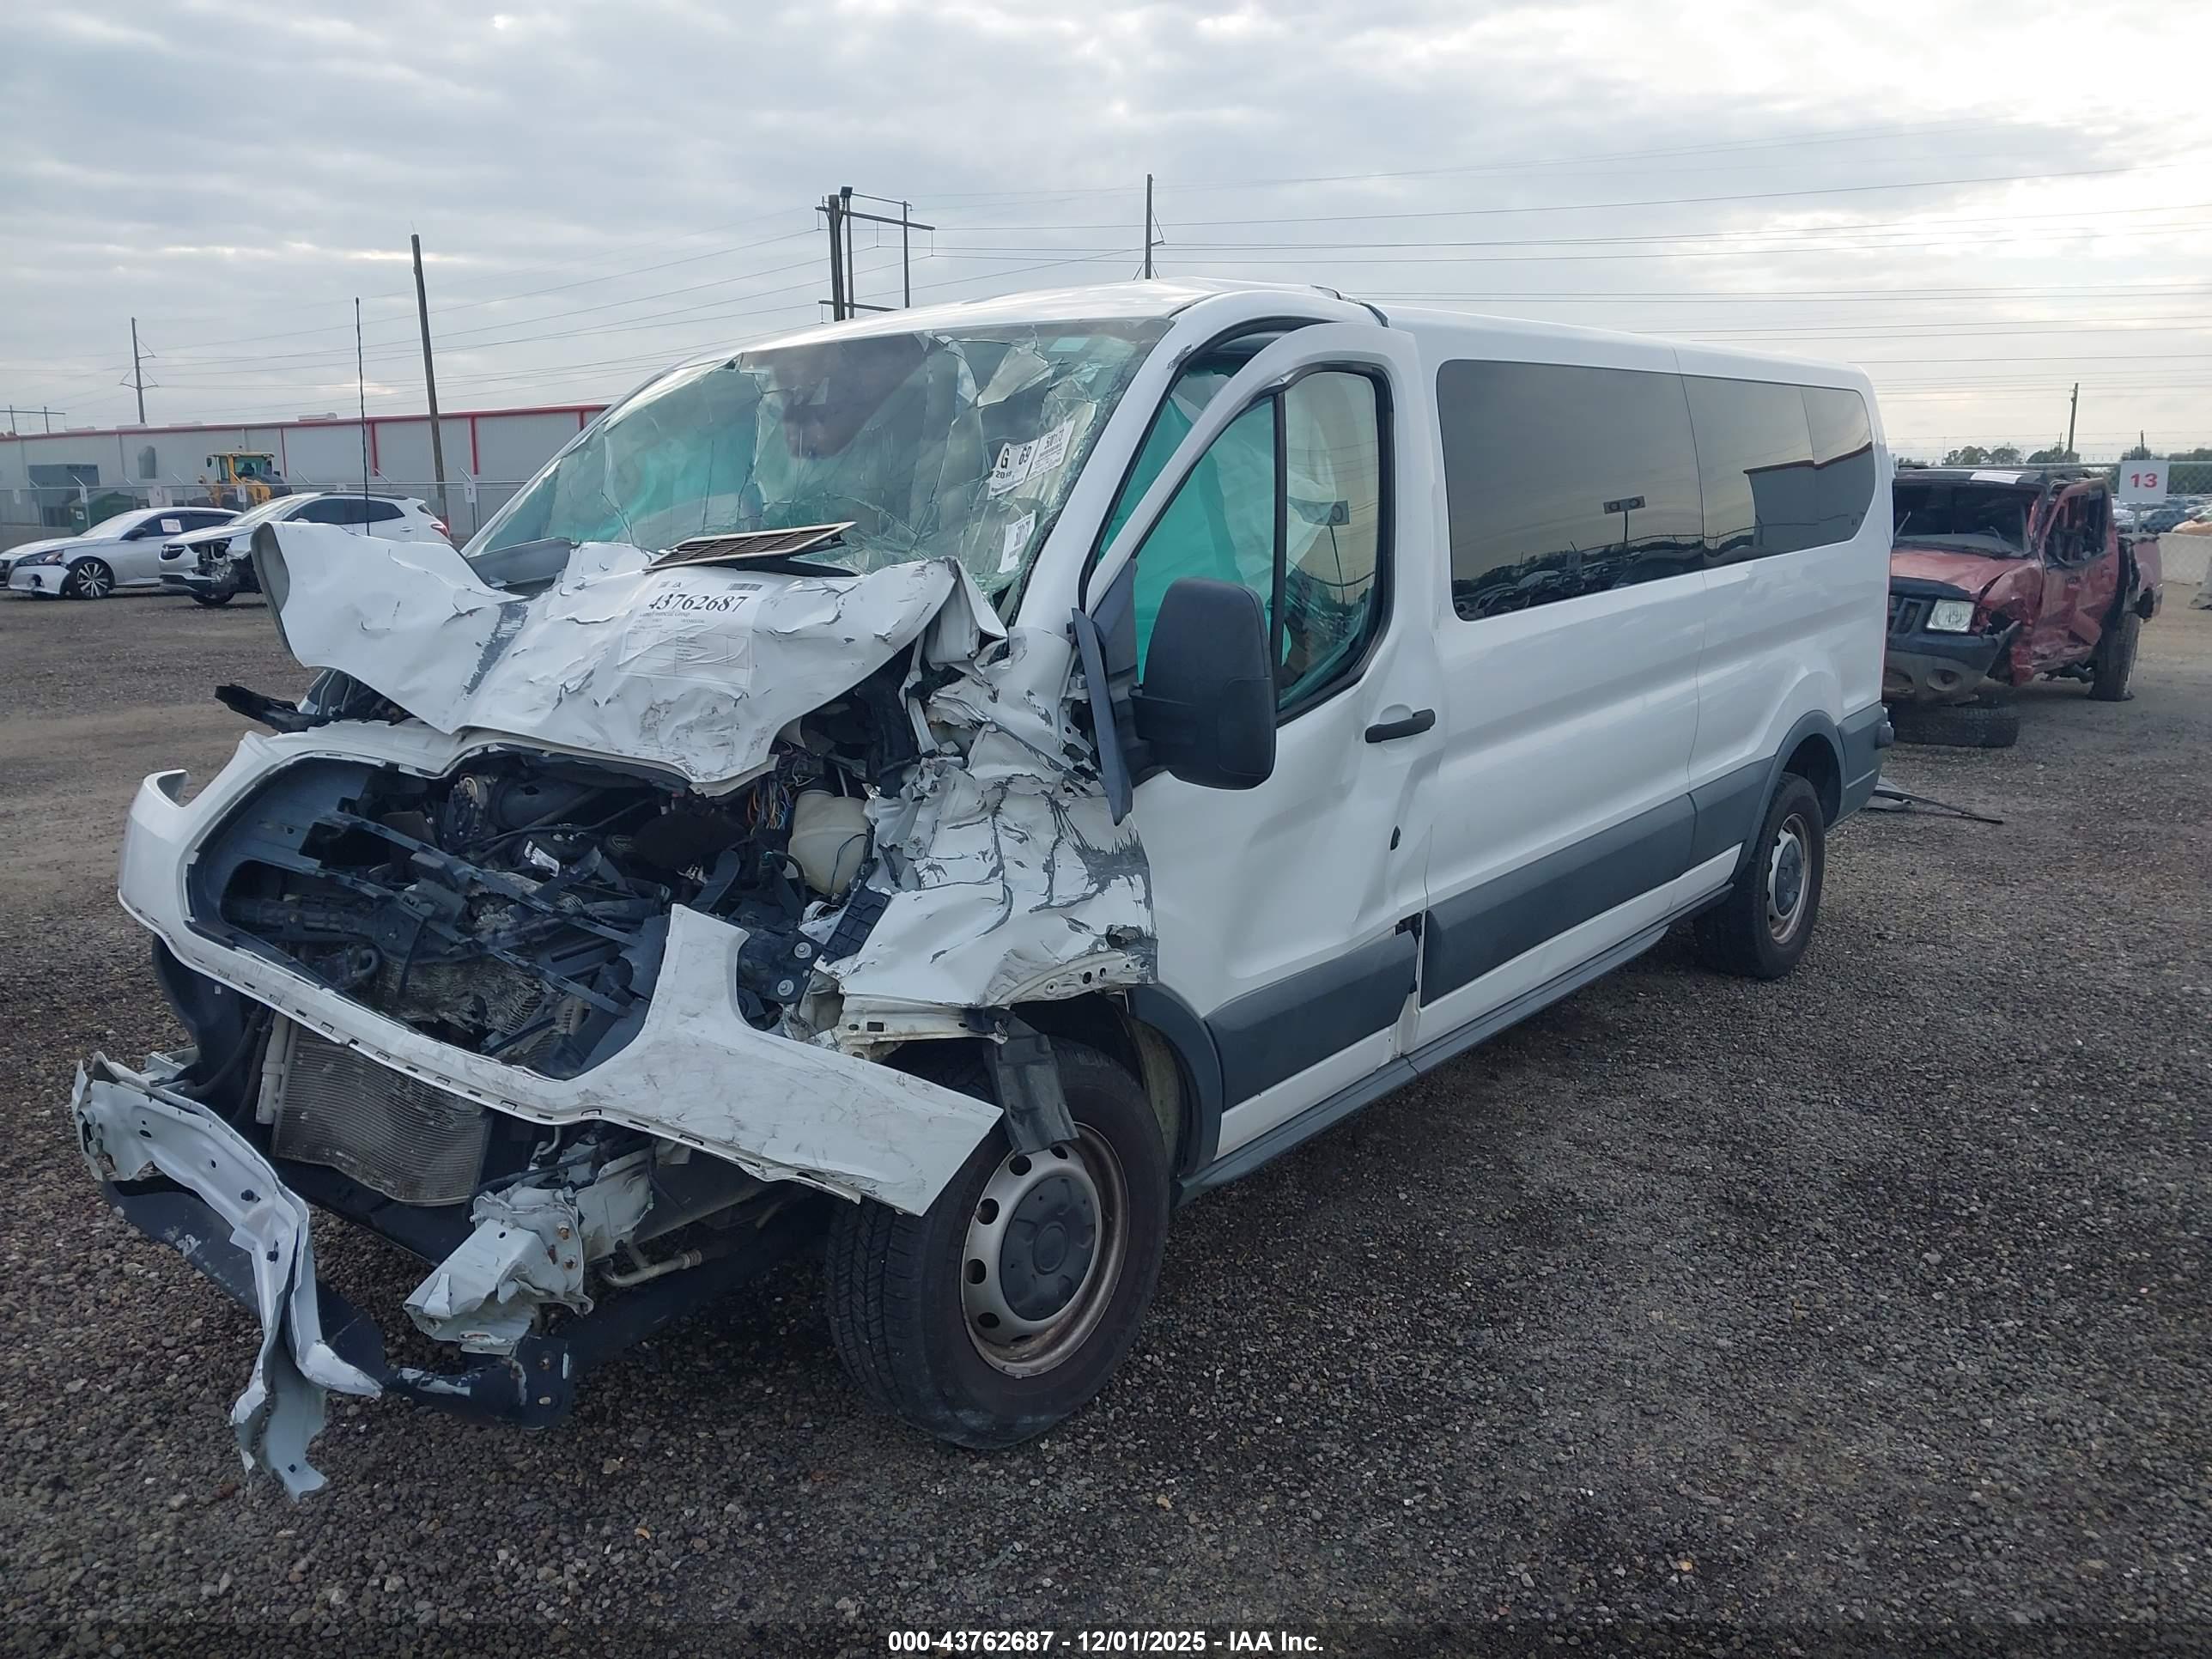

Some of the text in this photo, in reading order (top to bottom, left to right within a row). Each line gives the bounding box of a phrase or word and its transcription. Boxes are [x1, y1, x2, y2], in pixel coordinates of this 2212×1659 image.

[1000, 447, 1010, 469] G
[1018, 446, 1032, 465] 69
[2130, 473, 2158, 488] 13
[648, 593, 749, 612] 43762687
